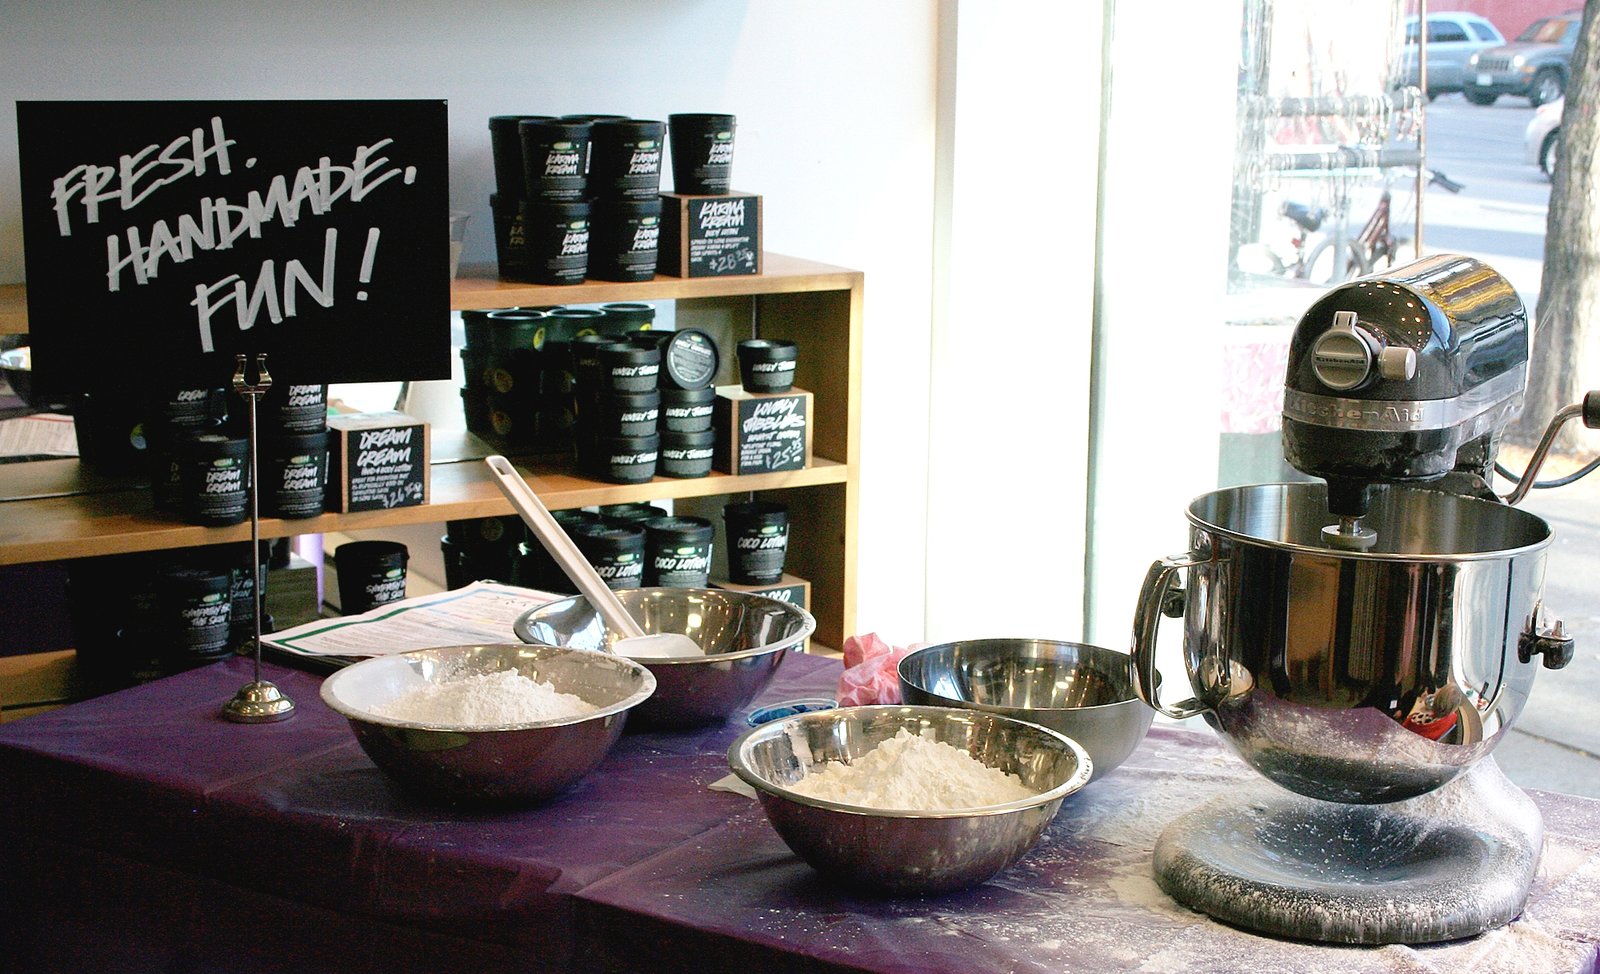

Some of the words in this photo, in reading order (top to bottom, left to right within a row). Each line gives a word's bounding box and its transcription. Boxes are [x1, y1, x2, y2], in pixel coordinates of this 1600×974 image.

[51, 116, 258, 236] FRESH.
[107, 138, 417, 292] HANDMADE.
[699, 199, 745, 219] KARMA
[753, 398, 799, 417] LOVELY
[359, 427, 412, 449] DREAM
[357, 447, 411, 467] CREAM
[206, 469, 241, 482] DREAM
[284, 466, 318, 480] DREAM
[206, 481, 241, 492] CREAM
[284, 477, 318, 489] CREAM
[738, 537, 760, 549] COCO
[655, 556, 676, 569] COCO
